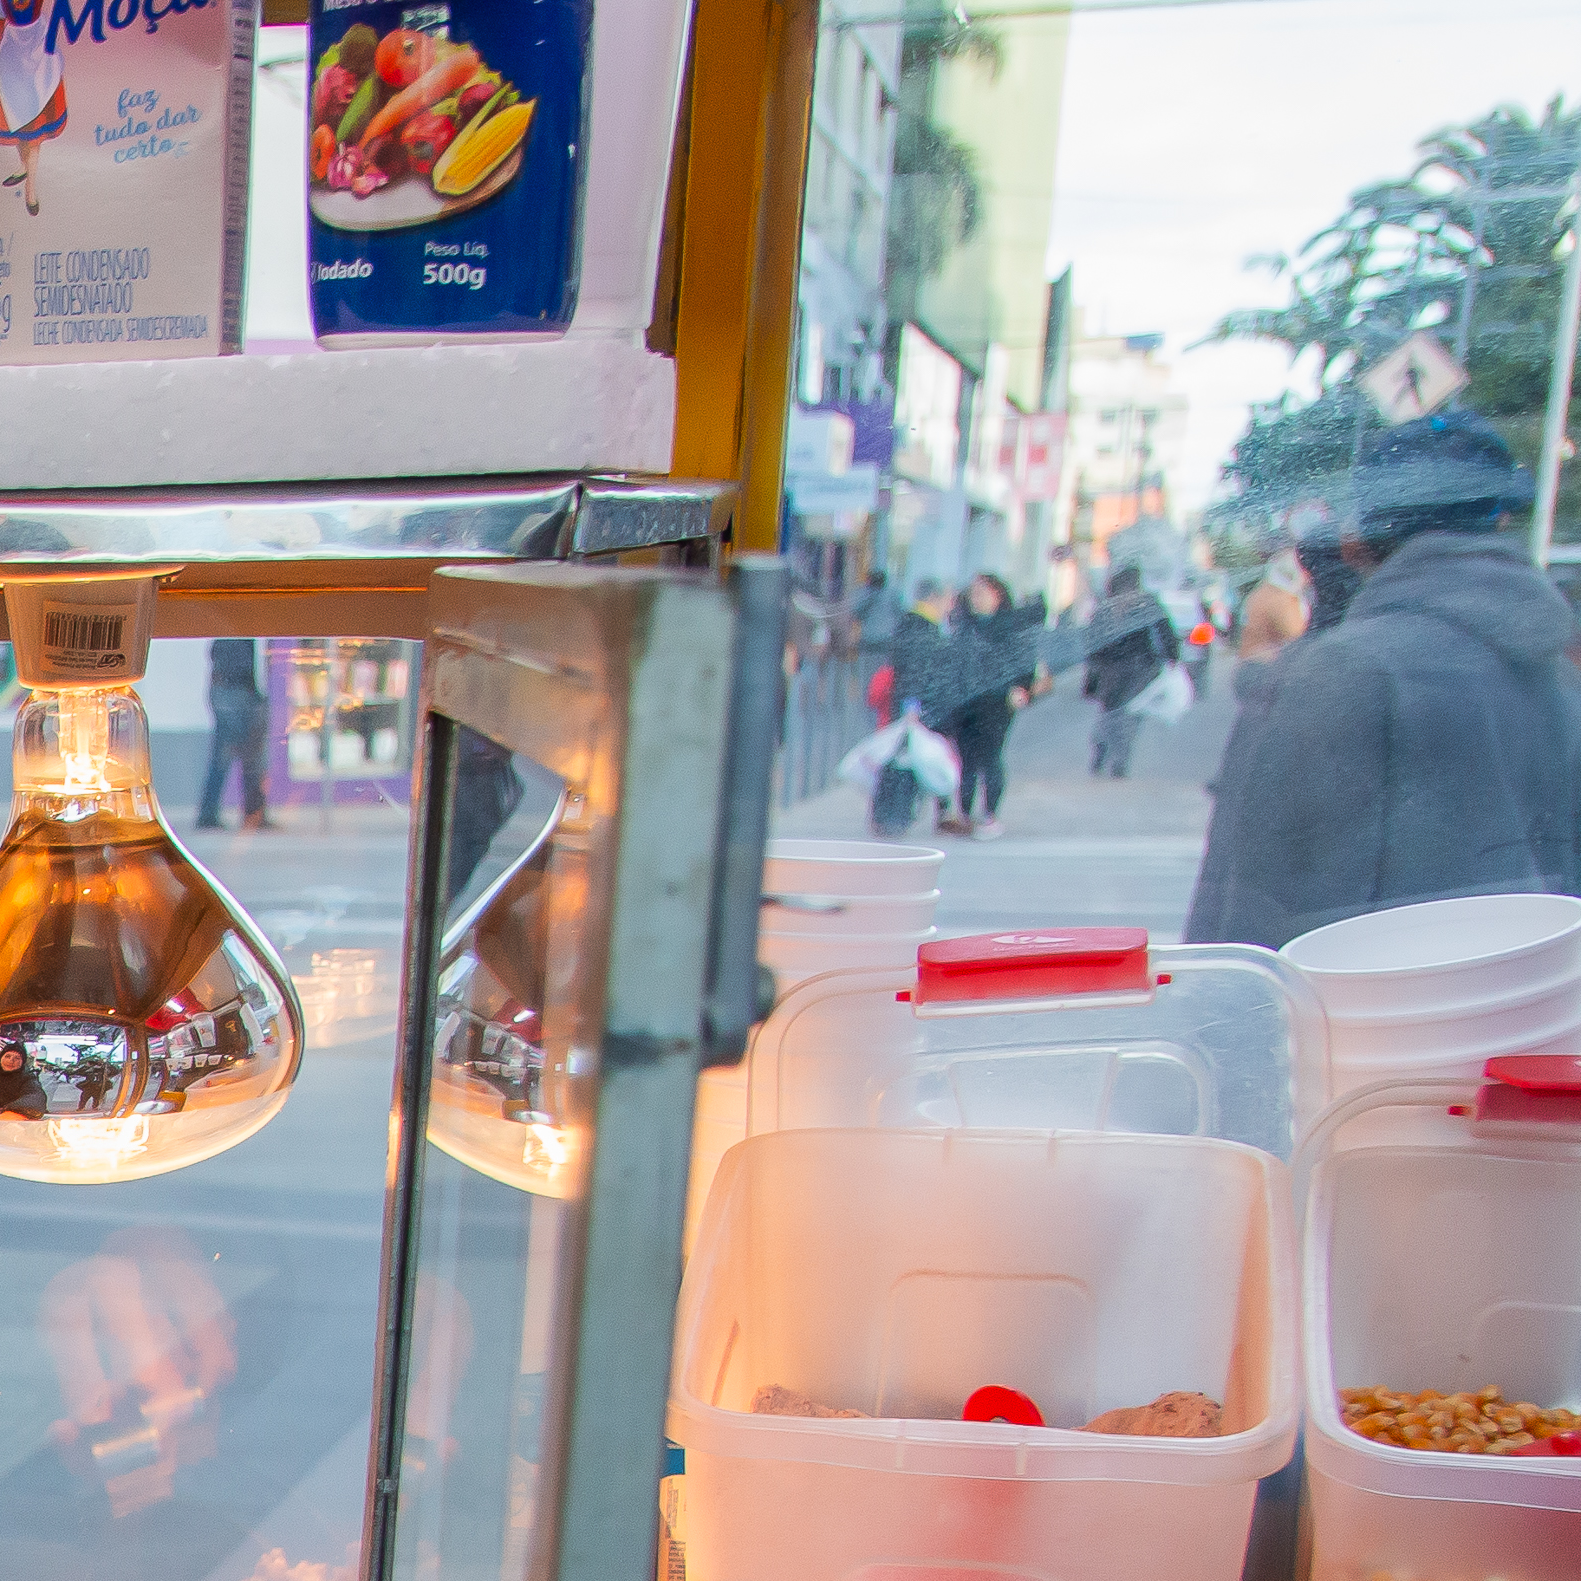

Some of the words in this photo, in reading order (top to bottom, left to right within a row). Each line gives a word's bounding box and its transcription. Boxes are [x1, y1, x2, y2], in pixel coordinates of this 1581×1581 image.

[117, 87, 162, 119] faz
[94, 115, 153, 147] tudo
[155, 104, 203, 132] dar
[114, 133, 176, 164] certo
[425, 240, 461, 257] Peso
[65, 247, 150, 284] CONDENSADO
[423, 262, 487, 290] 500g
[34, 281, 134, 317] SEMIDESNATADO
